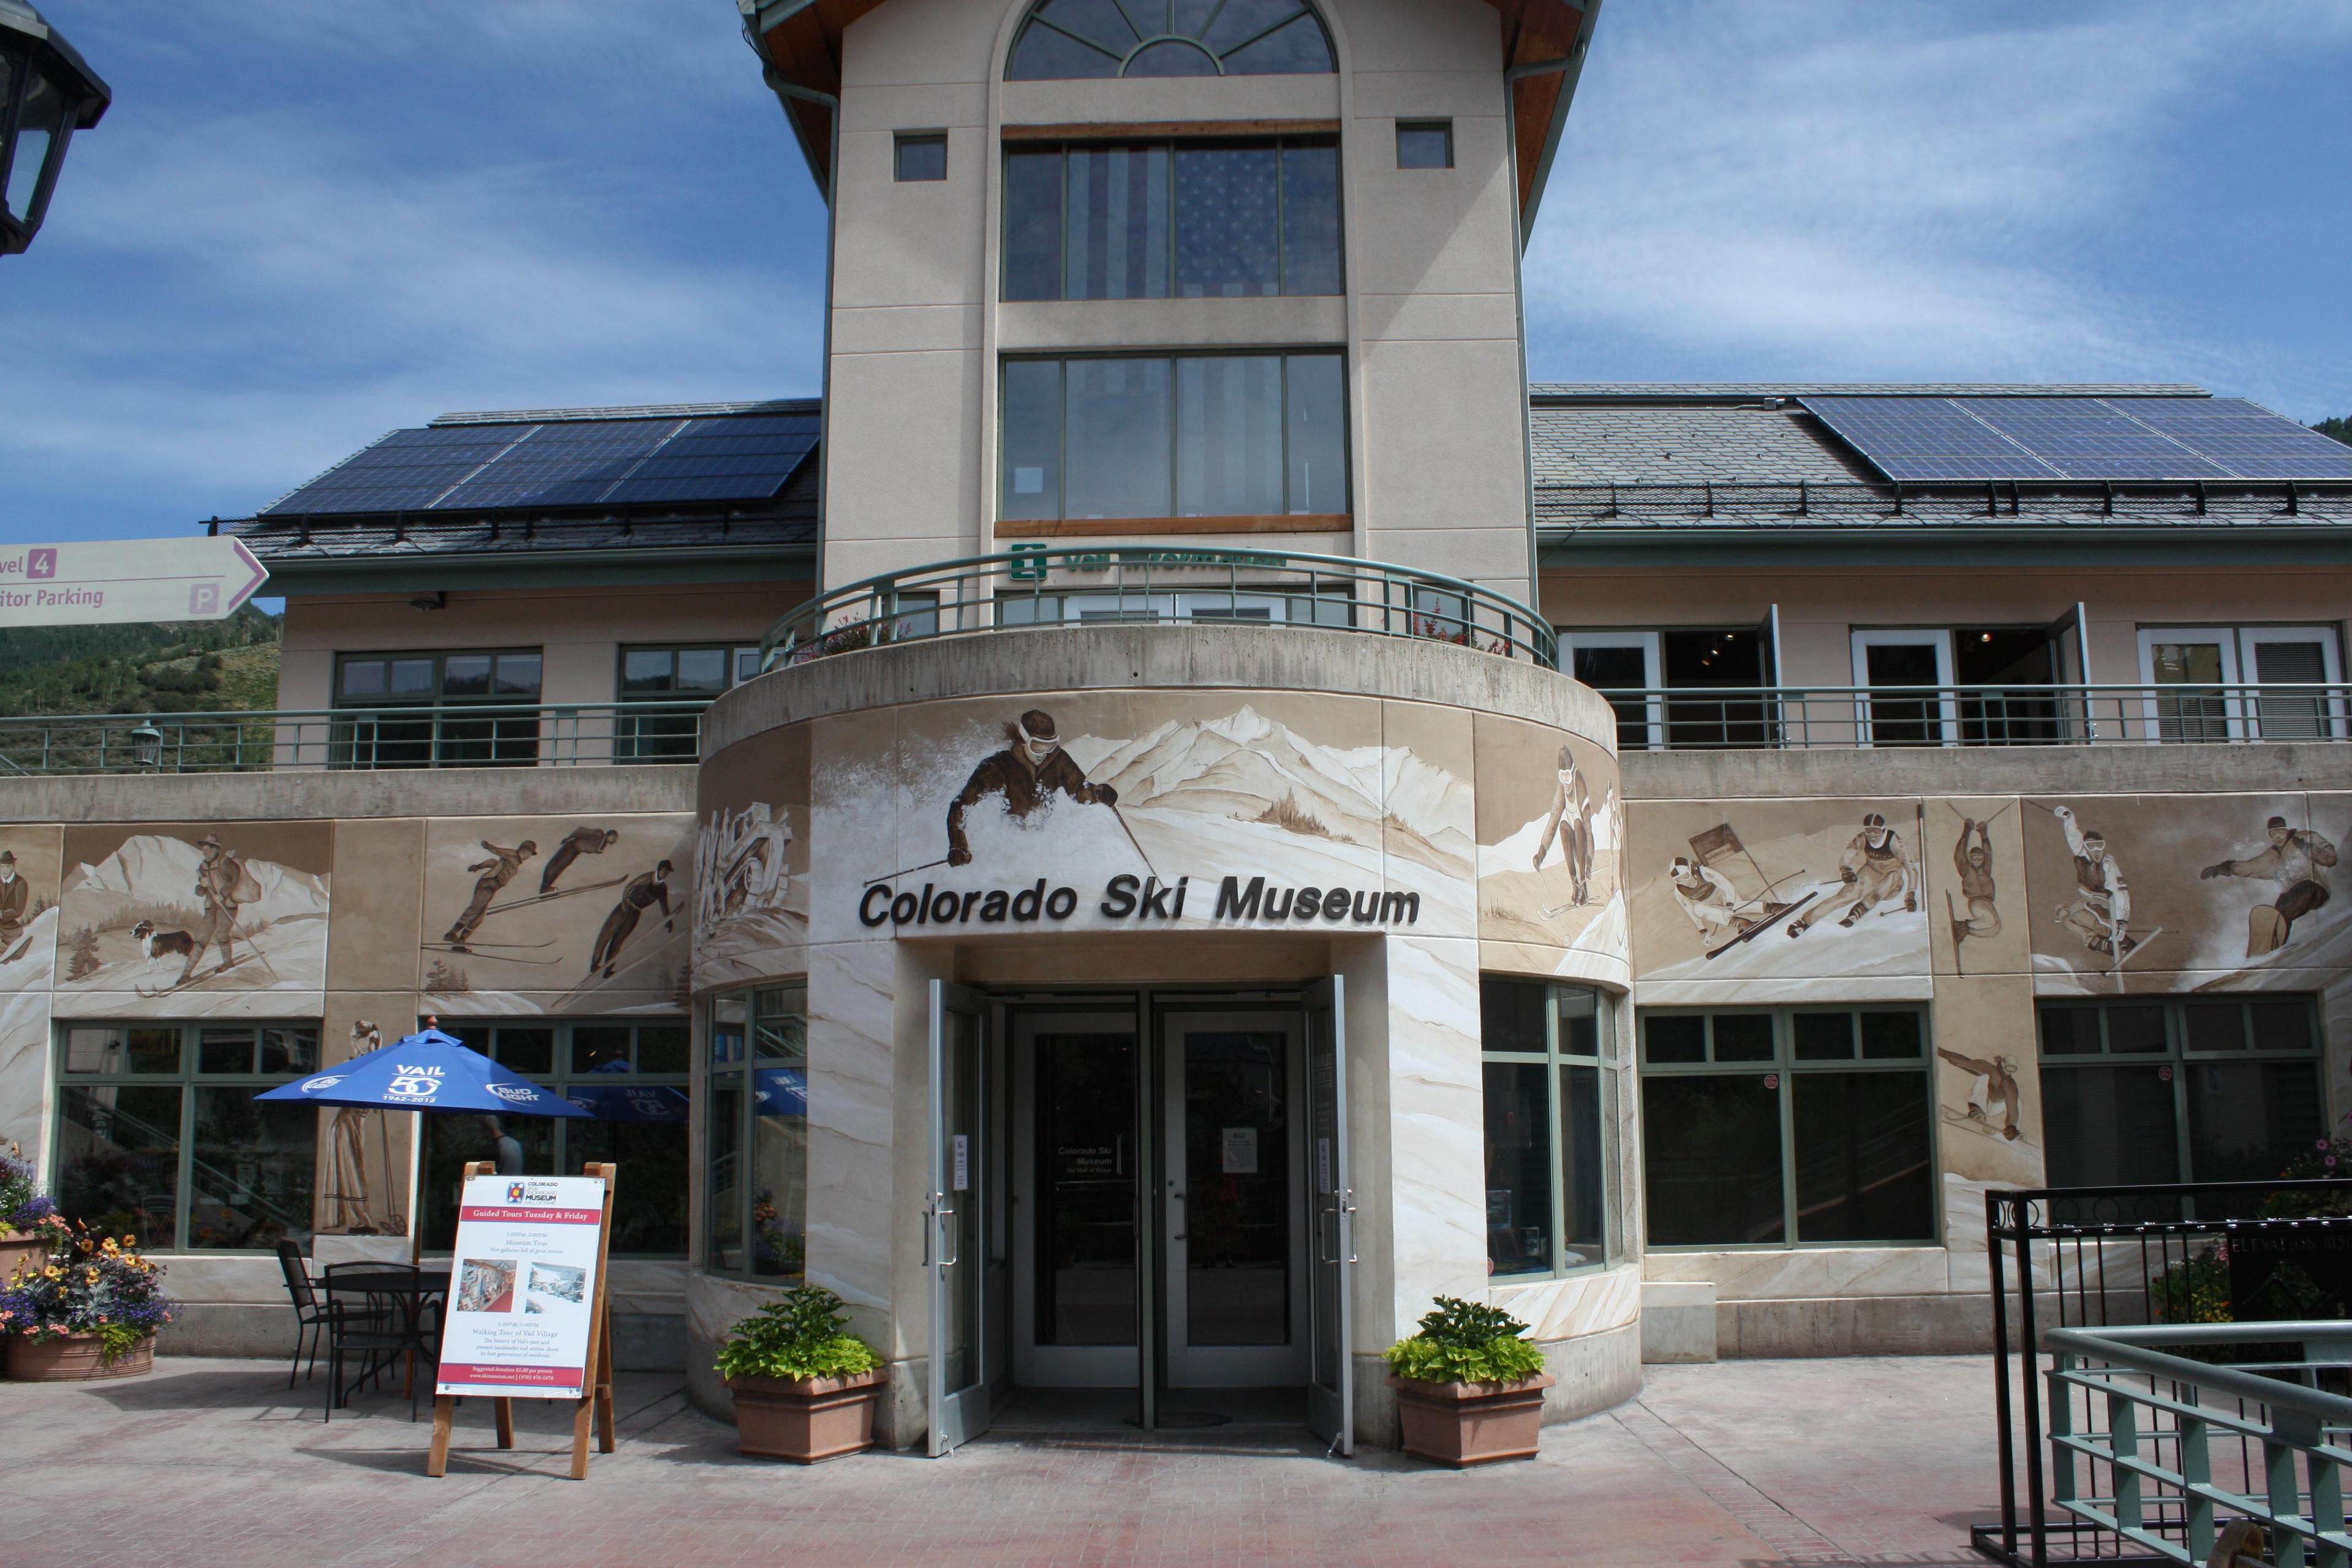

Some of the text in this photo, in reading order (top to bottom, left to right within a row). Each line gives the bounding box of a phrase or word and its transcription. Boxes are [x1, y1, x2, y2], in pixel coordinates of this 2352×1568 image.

[34, 552, 50, 575] 4
[37, 588, 104, 608] Parking
[198, 588, 213, 609] P
[859, 874, 1420, 926] Colorado Ski Museum
[396, 1065, 445, 1076] VAIL
[382, 1095, 437, 1103] 1962-2012
[498, 1092, 540, 1101] LIGHT
[1058, 1147, 1112, 1155] Colorado Ski
[524, 1211, 554, 1219] Tuesday
[564, 1212, 588, 1221] Friday
[473, 1328, 497, 1336] Walking
